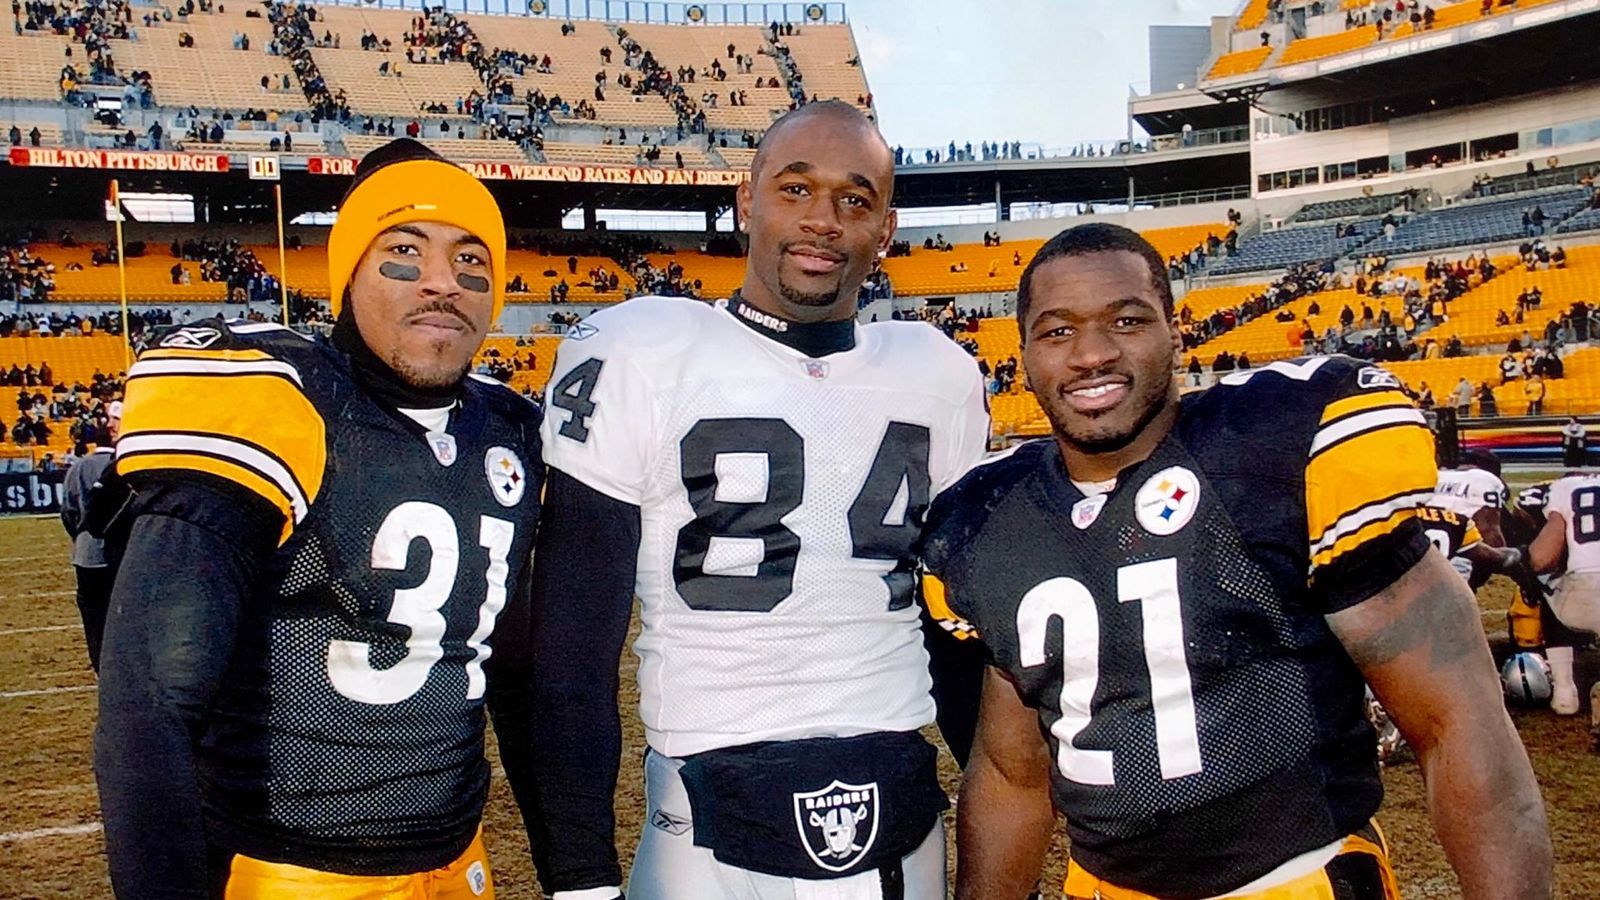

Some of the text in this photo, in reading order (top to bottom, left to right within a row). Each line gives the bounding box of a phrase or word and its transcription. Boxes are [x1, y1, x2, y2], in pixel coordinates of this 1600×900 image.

[29, 150, 218, 172] HILTON PITTSBURGH
[321, 158, 355, 175] FOR
[460, 163, 506, 179] BALL
[508, 165, 582, 182] WEEKEND
[585, 168, 630, 183] RATES
[632, 170, 664, 185] AND
[665, 171, 694, 185] FAN
[738, 303, 788, 333] RAIDERS
[552, 357, 604, 443] 4
[672, 417, 931, 612] 84
[327, 501, 515, 705] 31
[1017, 557, 1203, 786] 21
[805, 790, 870, 810] RAIDERS
